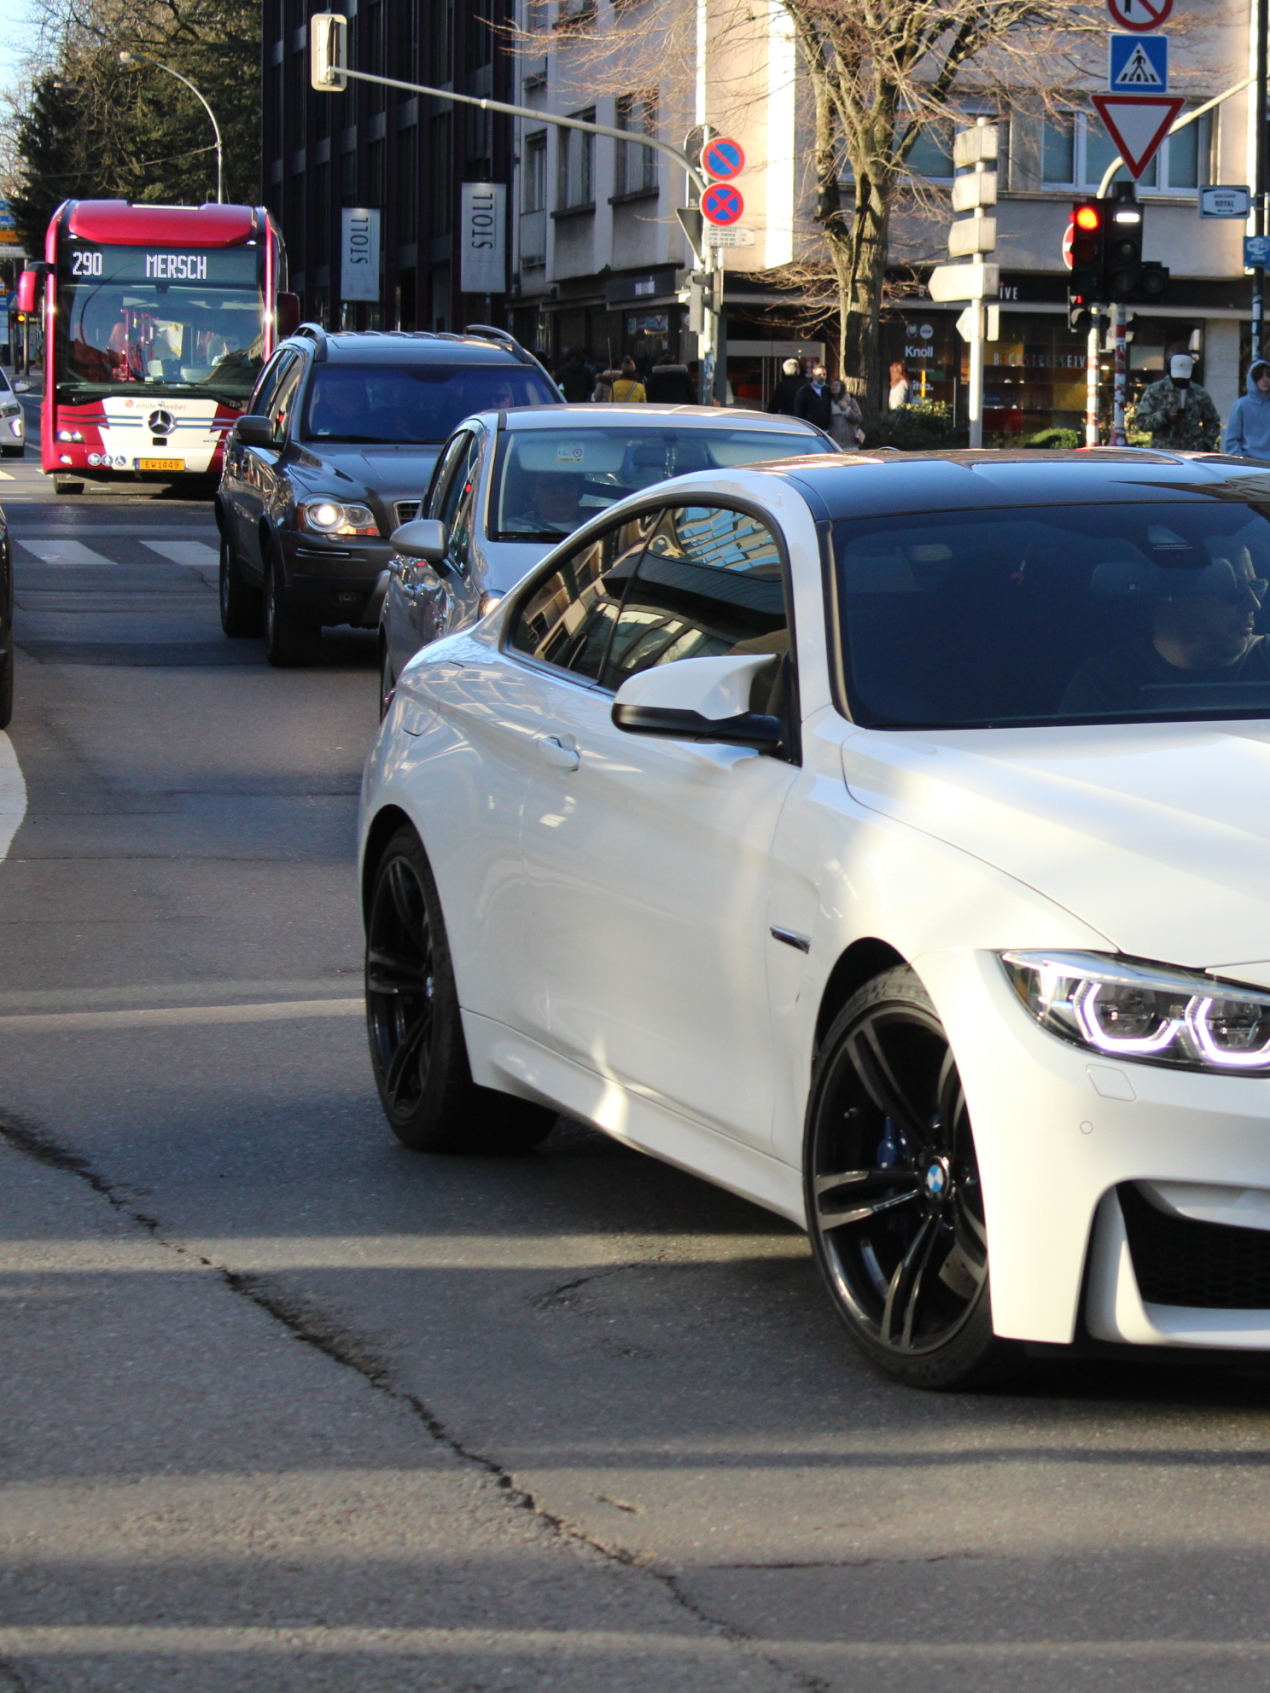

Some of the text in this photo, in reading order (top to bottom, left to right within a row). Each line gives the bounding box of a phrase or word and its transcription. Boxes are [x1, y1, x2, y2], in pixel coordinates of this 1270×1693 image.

[472, 192, 493, 249] STOLL
[350, 216, 369, 265] STOLL
[72, 252, 207, 279] 290 MERSCH
[905, 345, 934, 358] Knoll
[145, 460, 180, 470] EW 1449
